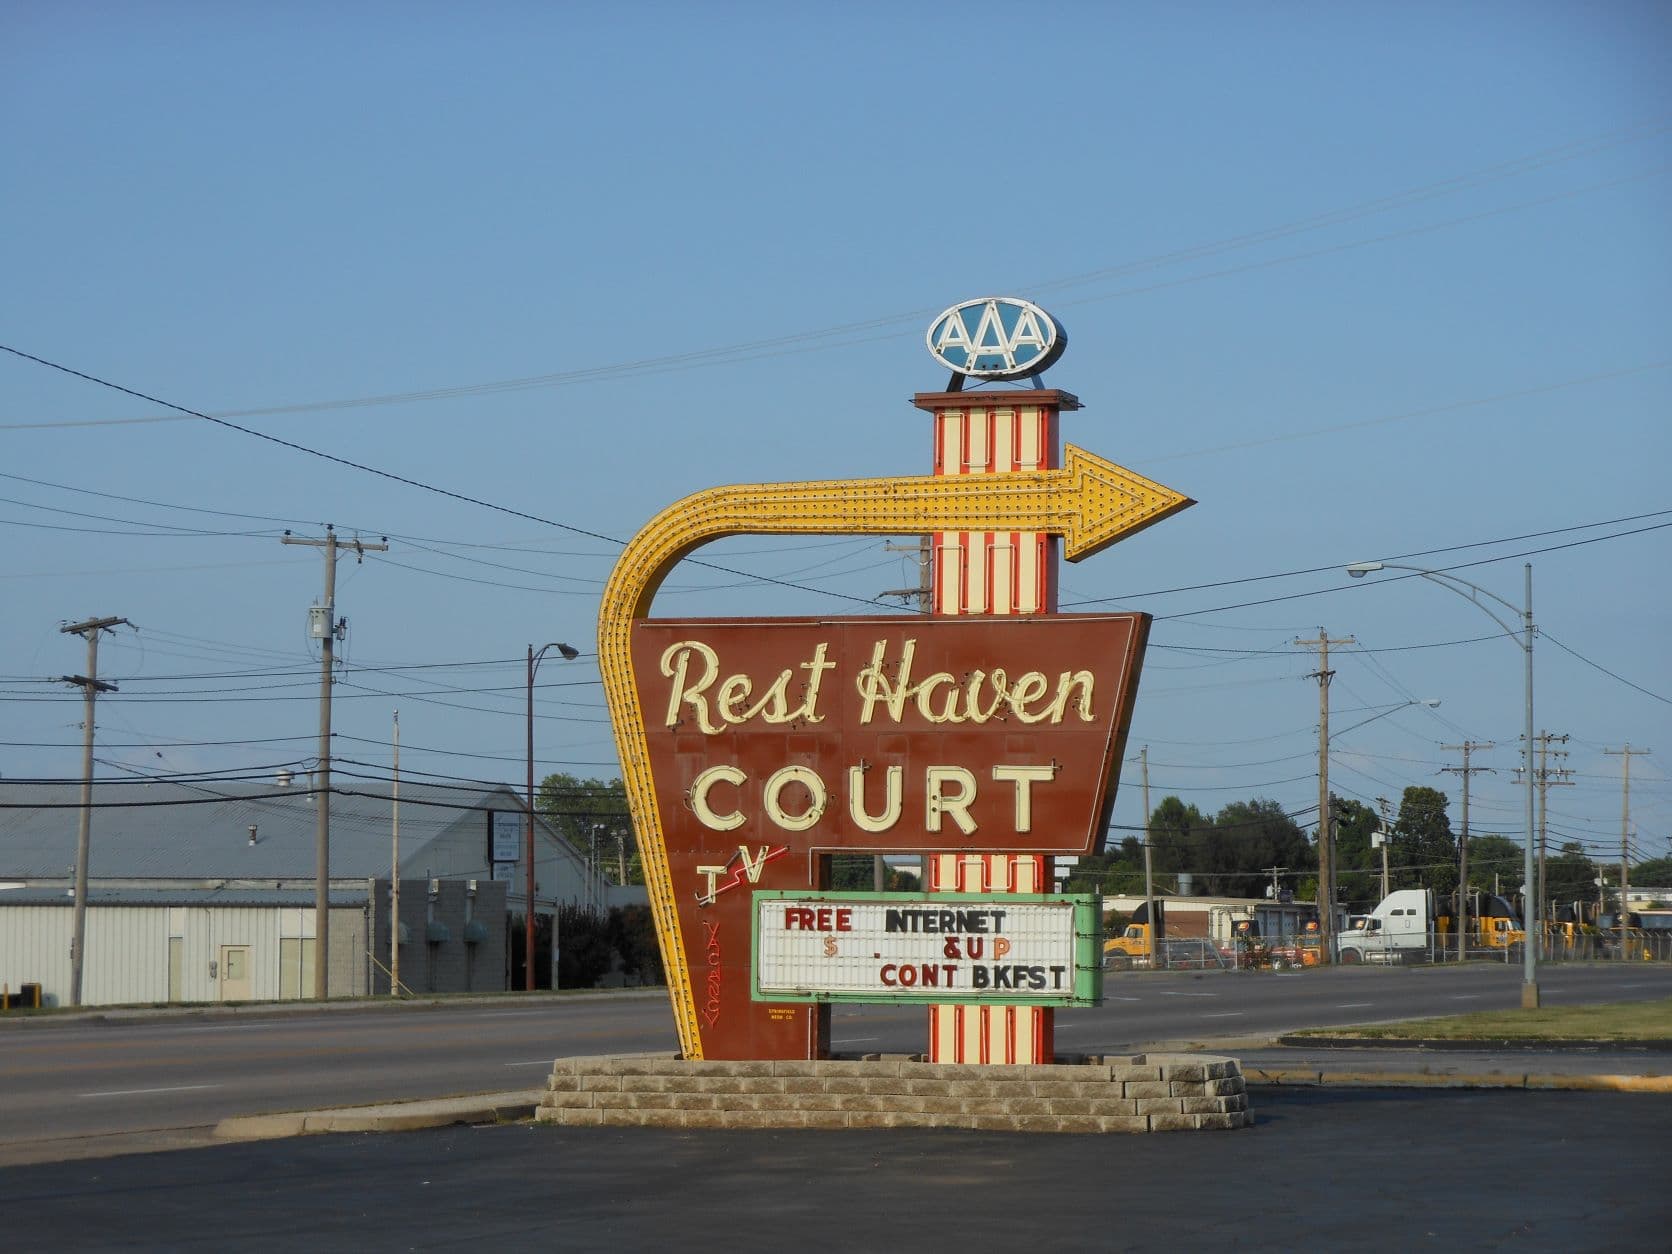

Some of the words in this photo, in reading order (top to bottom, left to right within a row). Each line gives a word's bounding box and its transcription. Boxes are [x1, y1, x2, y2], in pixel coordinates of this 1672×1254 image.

[936, 299, 1046, 372] AAA
[661, 640, 837, 735] Rest
[856, 638, 1096, 725] Haven
[691, 764, 1055, 835] COURT
[696, 845, 769, 904] TV
[785, 908, 852, 932] FREE
[823, 934, 838, 957] $
[880, 963, 958, 988] CONT
[972, 964, 1066, 990] BKFST
